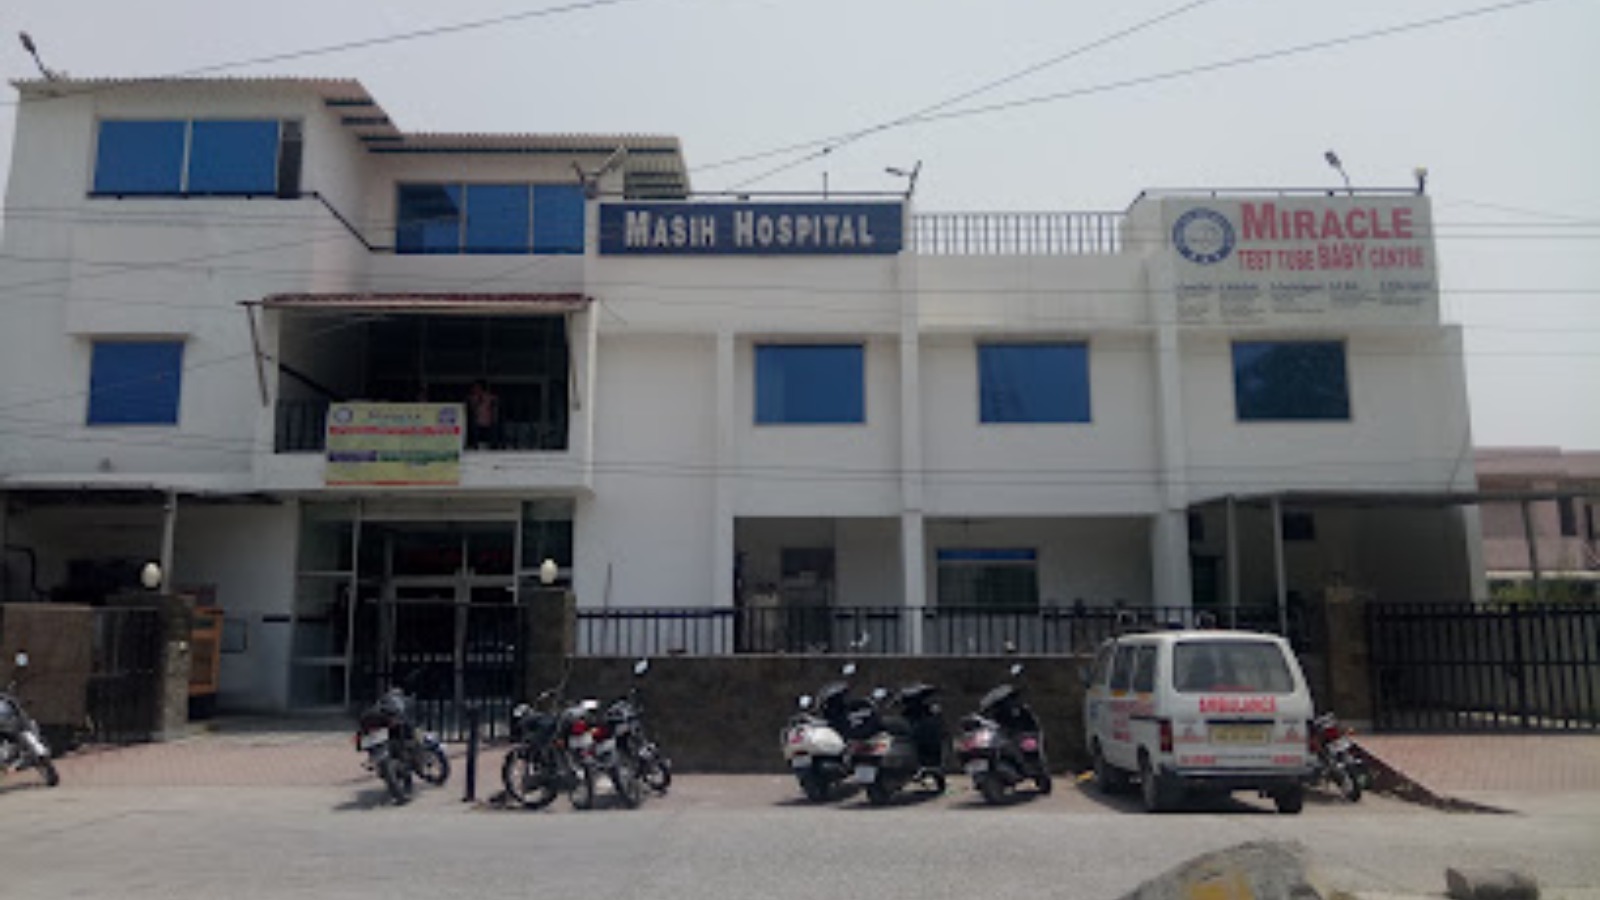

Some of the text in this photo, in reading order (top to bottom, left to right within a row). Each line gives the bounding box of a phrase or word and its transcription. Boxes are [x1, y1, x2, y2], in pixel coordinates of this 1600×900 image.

[625, 210, 873, 246] MASIH HOSPITAL
[1240, 203, 1413, 240] MIRACLE
[1318, 244, 1365, 270] BABY
[1199, 695, 1276, 713] AMBULANCE
